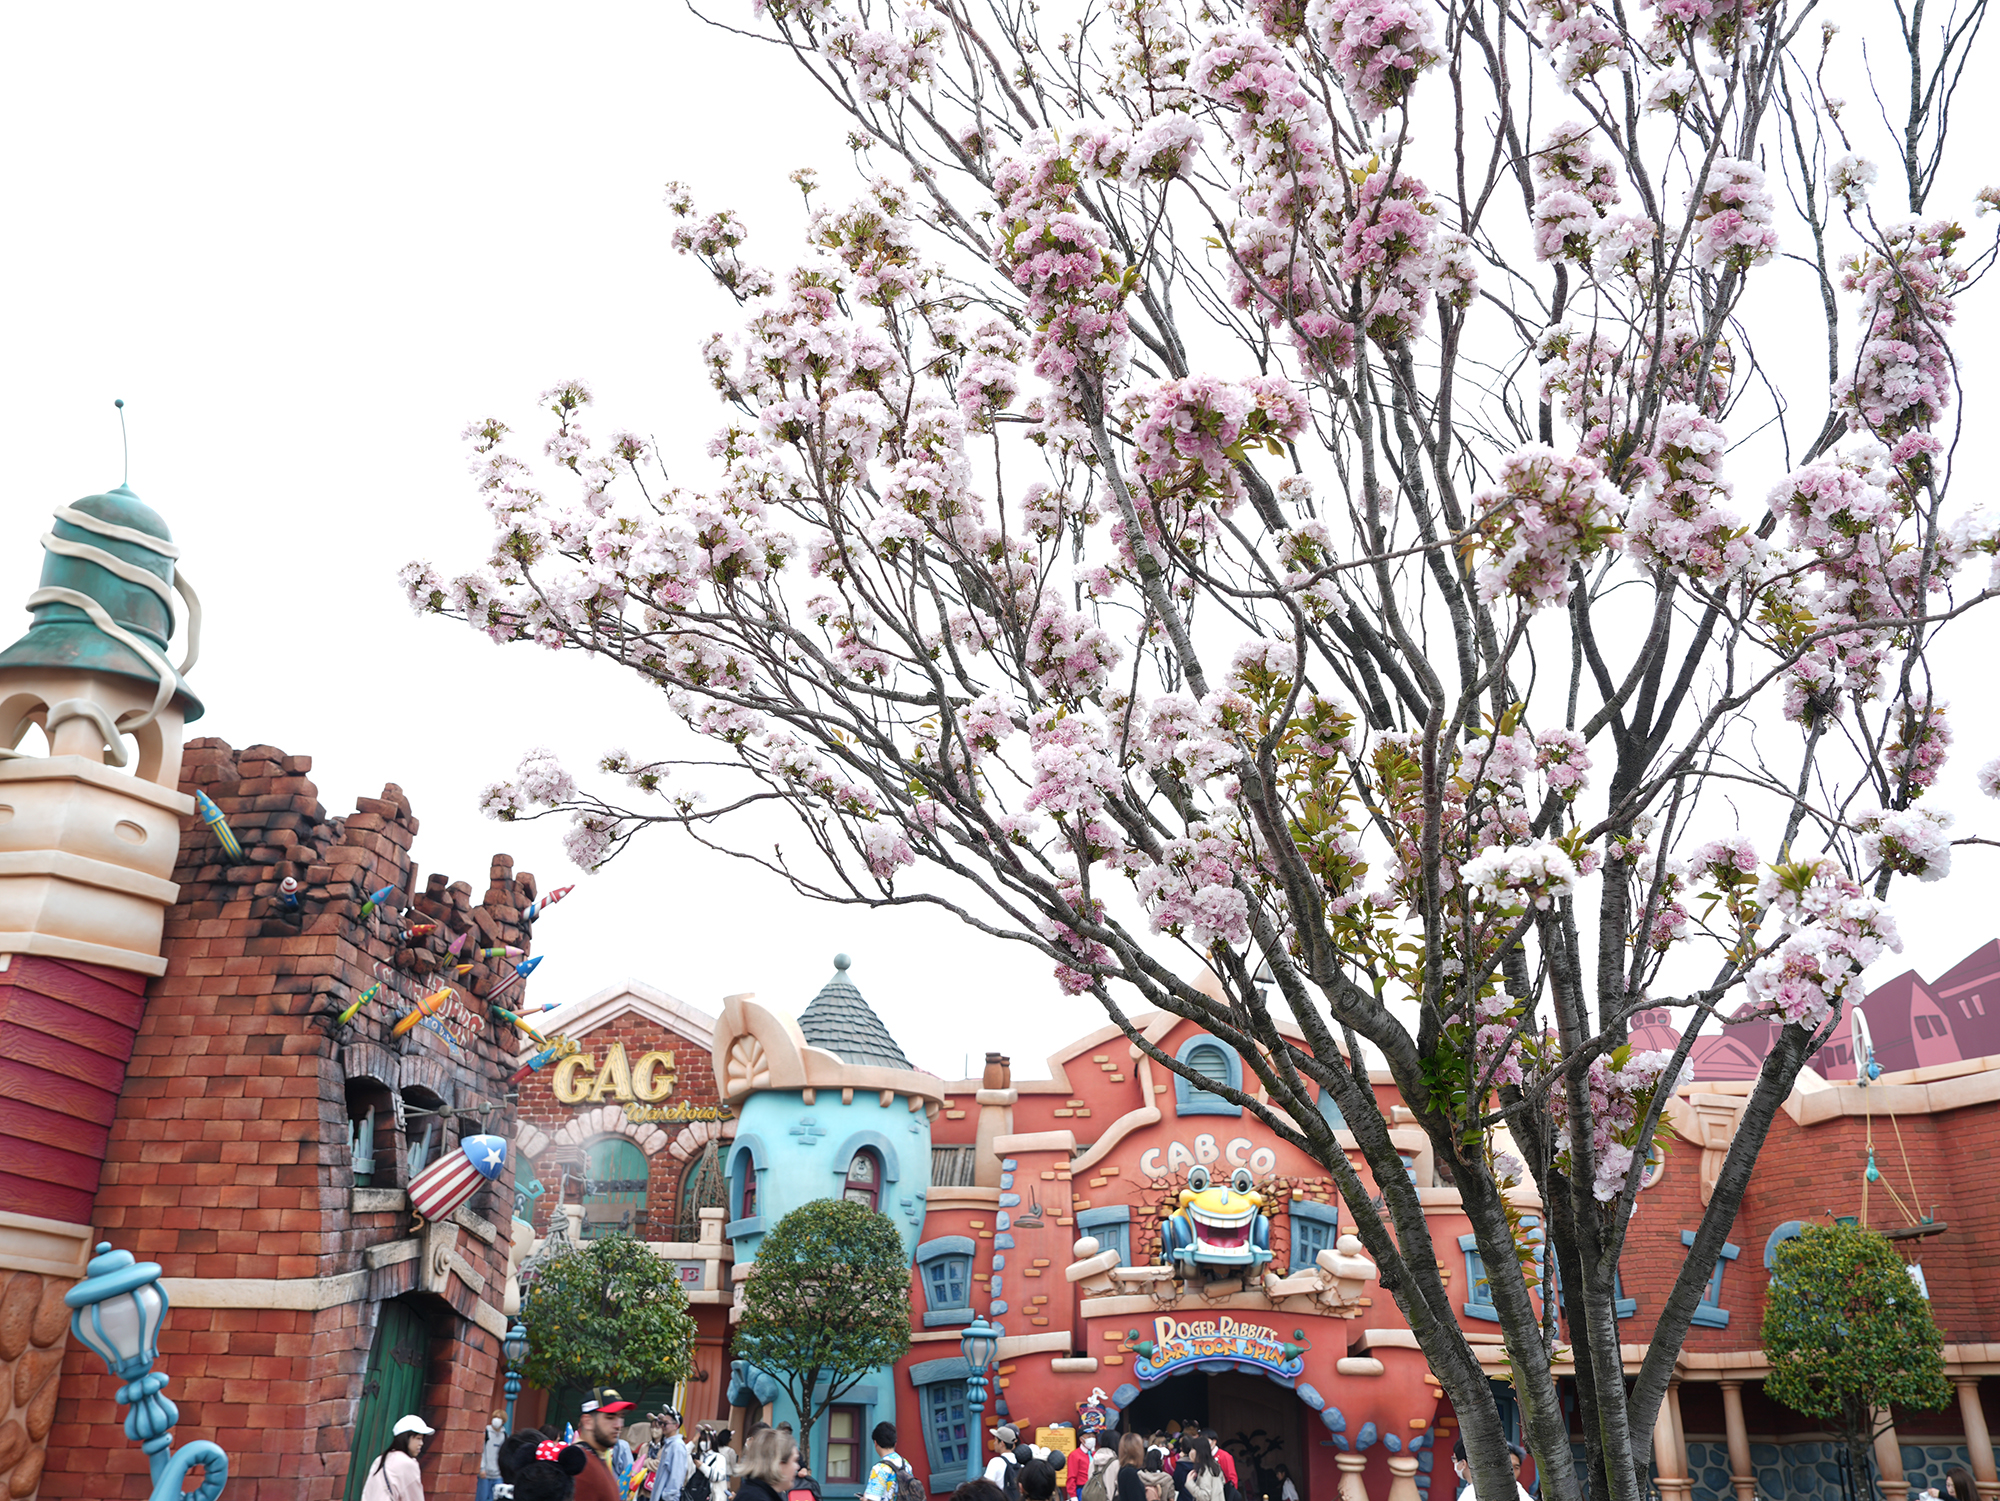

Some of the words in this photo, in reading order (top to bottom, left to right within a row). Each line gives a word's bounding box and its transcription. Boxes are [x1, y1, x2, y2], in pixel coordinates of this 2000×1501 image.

[552, 1041, 678, 1105] GAG
[1140, 1133, 1220, 1178] CAB
[1150, 1342, 1189, 1369] CAR
[1192, 1337, 1238, 1356] TOON
[1244, 1339, 1286, 1367] SPIN
[1153, 1316, 1216, 1352] ROGER
[1218, 1316, 1278, 1343] RABBIT'S
